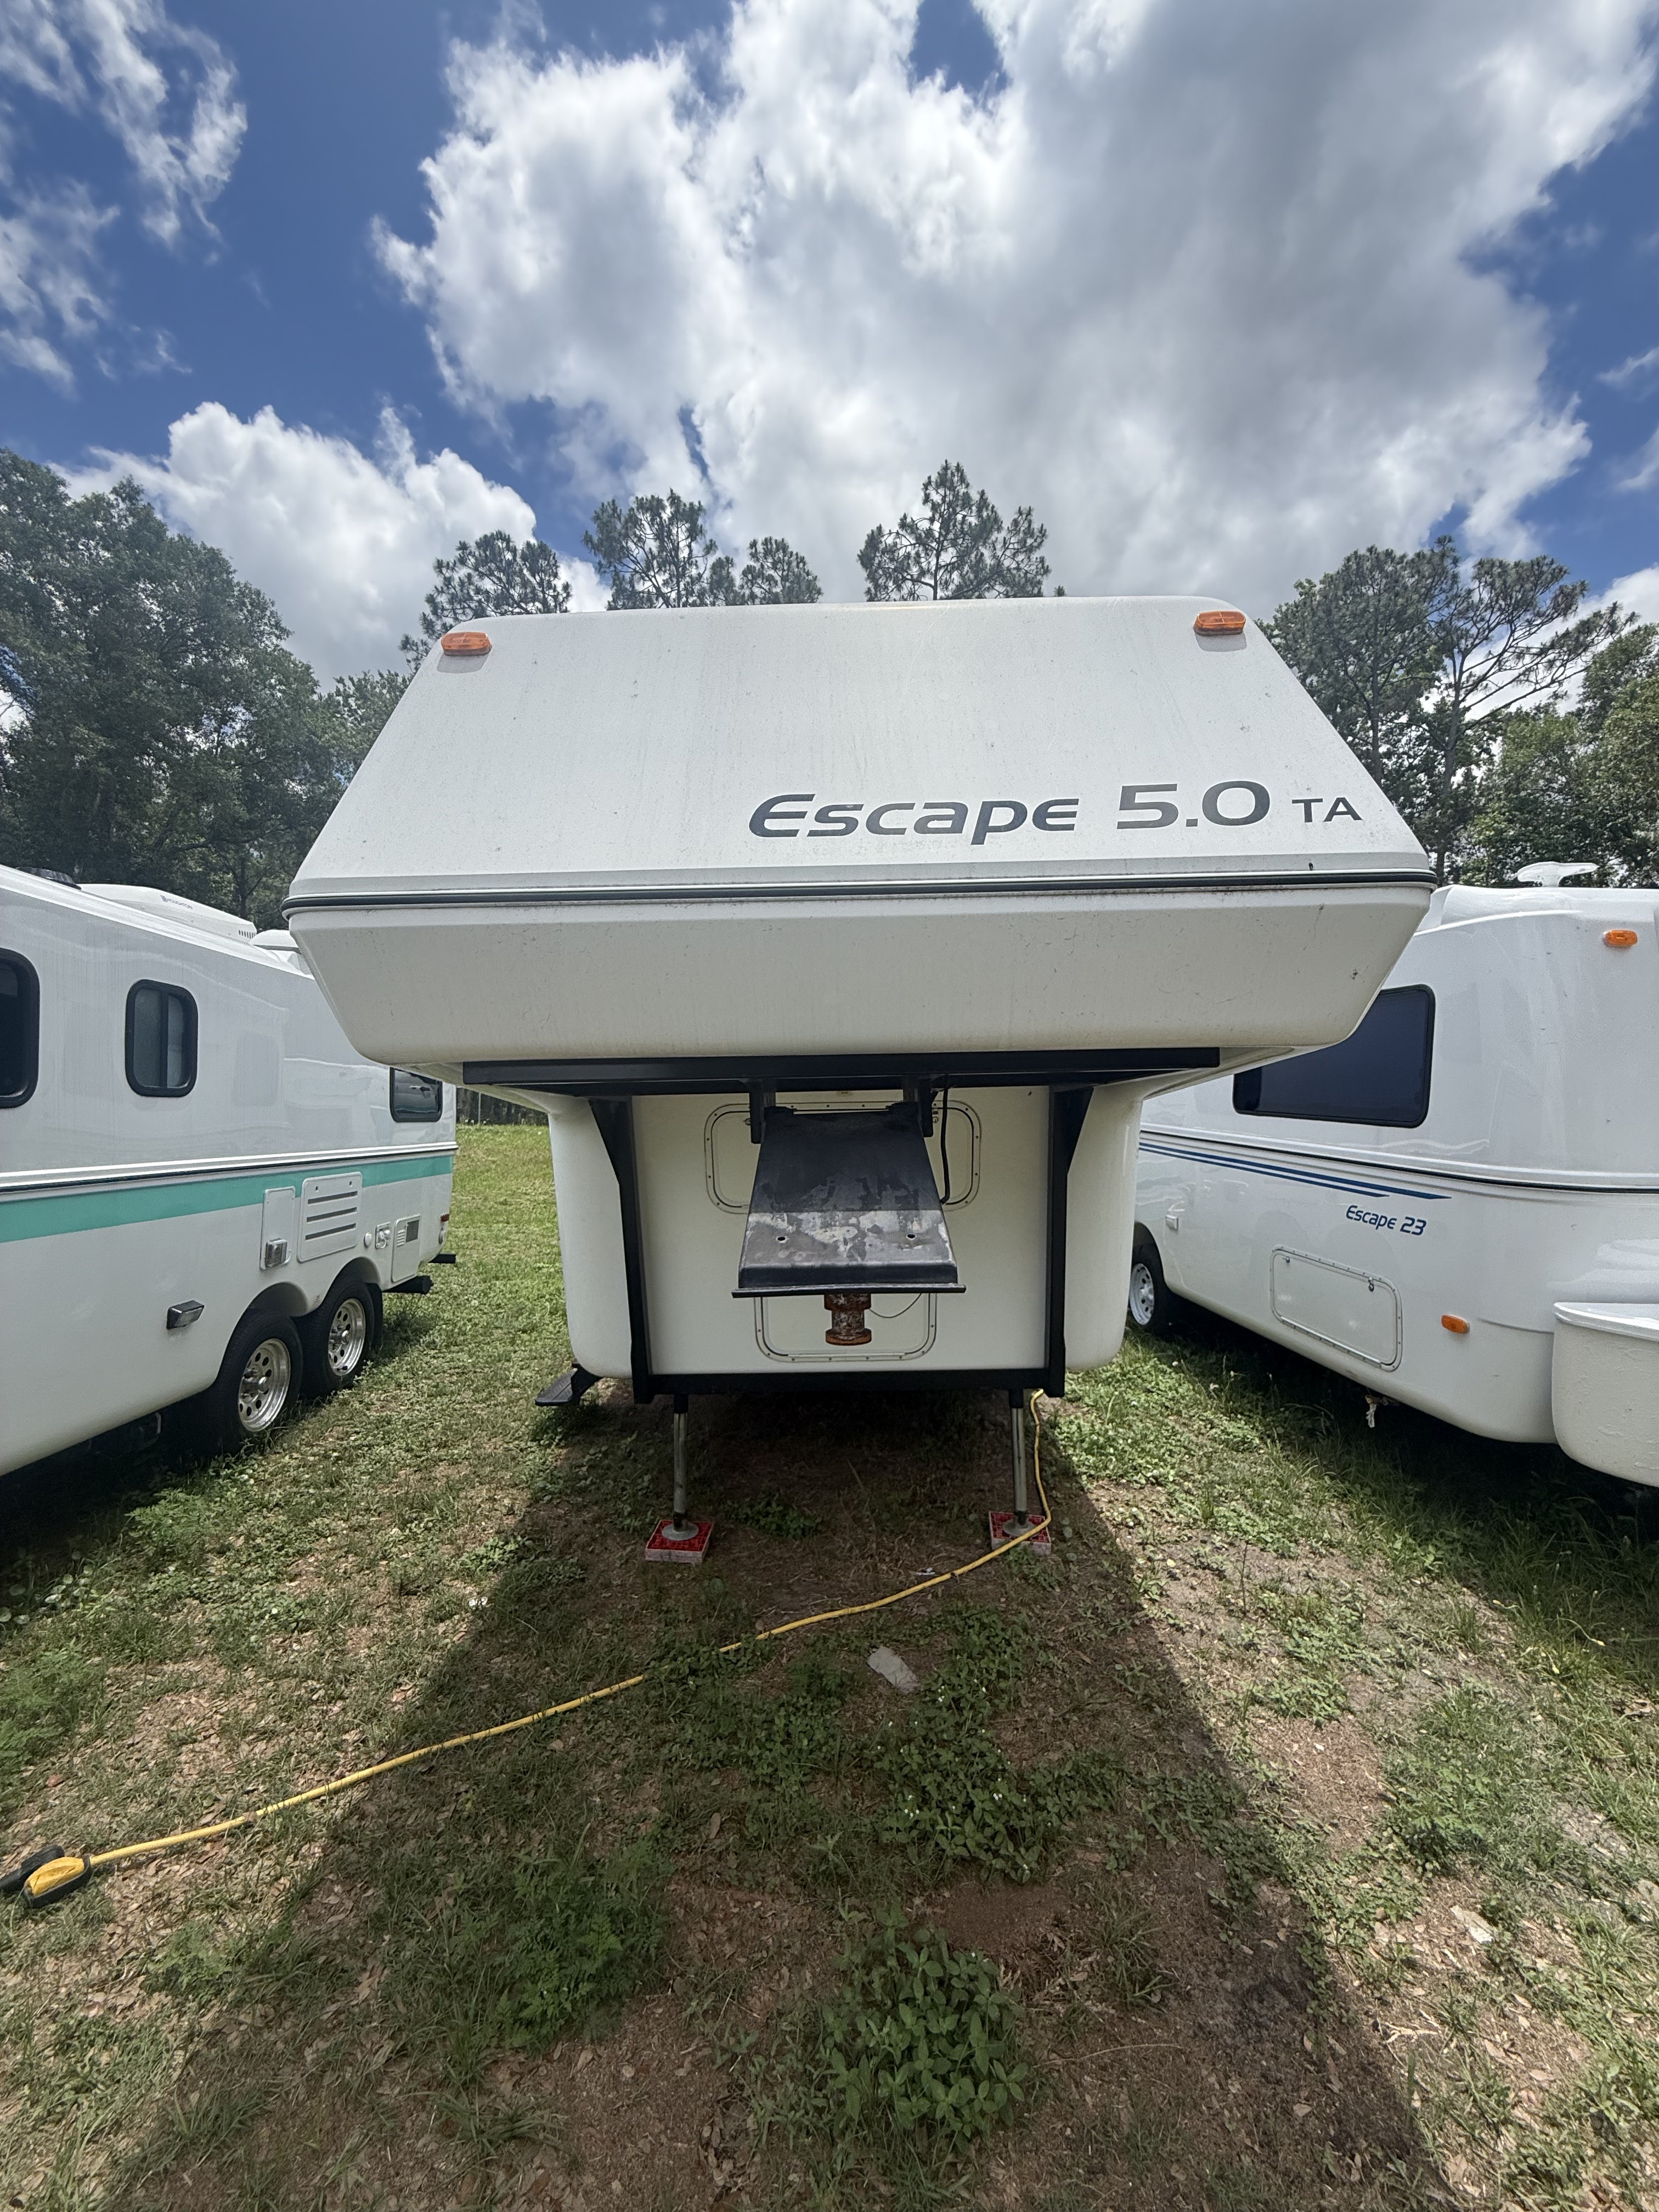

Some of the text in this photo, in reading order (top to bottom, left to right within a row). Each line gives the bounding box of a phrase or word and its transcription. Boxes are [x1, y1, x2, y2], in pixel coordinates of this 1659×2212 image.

[748, 781, 1363, 845] Escape 5.0 TA
[1346, 1205, 1427, 1236] Escape 23
